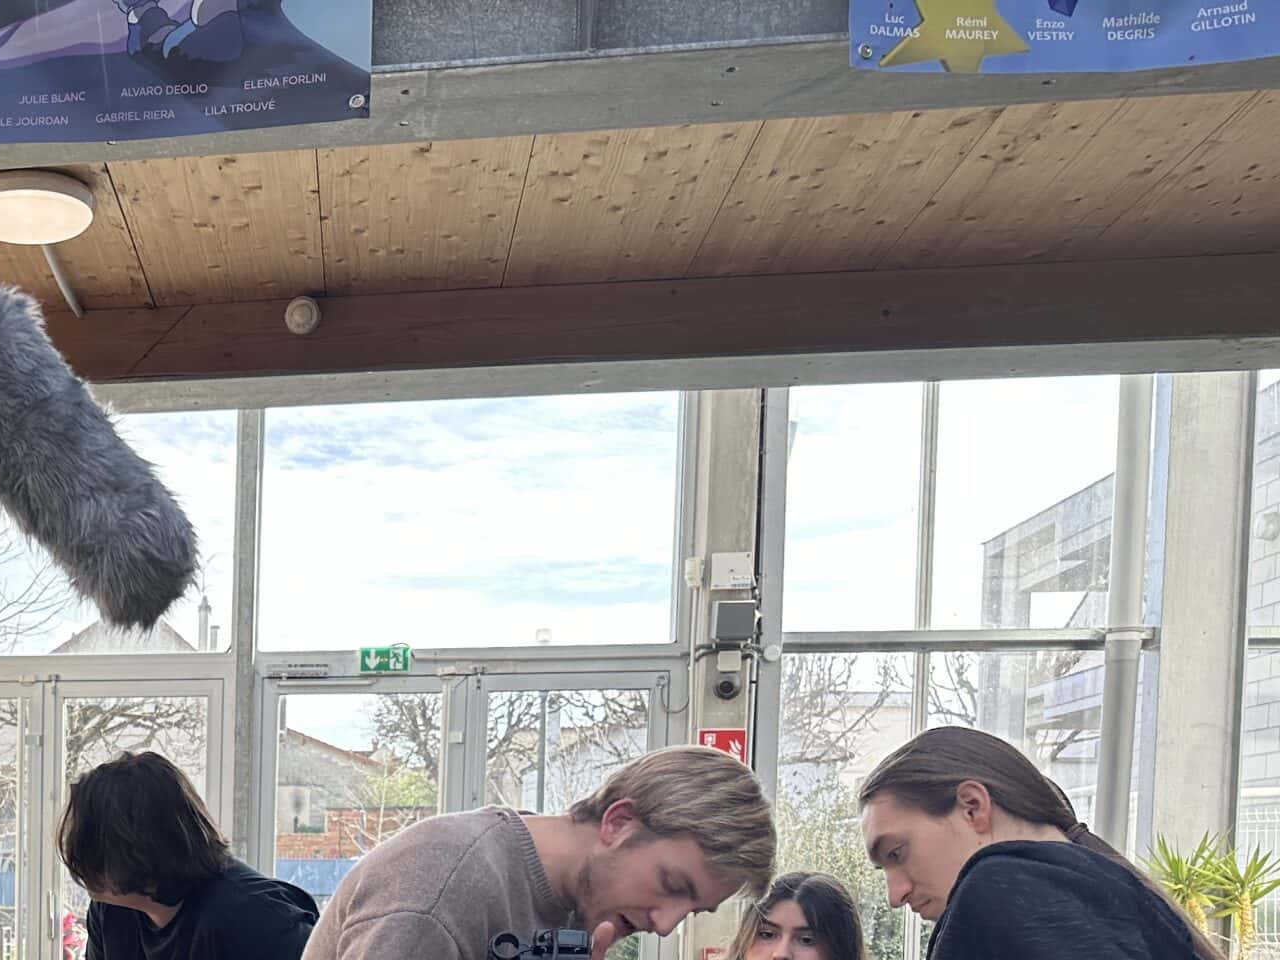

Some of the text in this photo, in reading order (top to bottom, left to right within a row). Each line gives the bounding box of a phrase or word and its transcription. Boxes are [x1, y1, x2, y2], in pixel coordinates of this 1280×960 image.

[1197, 0, 1249, 18] Arnaud
[885, 13, 904, 24] Luc
[956, 16, 987, 27] Rémi
[1036, 18, 1065, 29] Enzo
[1102, 12, 1161, 28] Mathilde
[1191, 13, 1256, 32] GILLOTIN
[870, 24, 920, 38] DALMAS
[945, 29, 999, 40] MAUREY
[1028, 30, 1074, 41] VESTRY
[1107, 28, 1155, 41] DEGRIS
[244, 72, 326, 90] ELENA FORLINI
[121, 83, 208, 97] ALVARO DEOLIO
[19, 91, 86, 105] JULIE BLANC
[205, 98, 276, 117] LILA TROUVÉ
[15, 116, 69, 127] JOURDAN
[96, 109, 175, 123] GABRIEL RIERA
